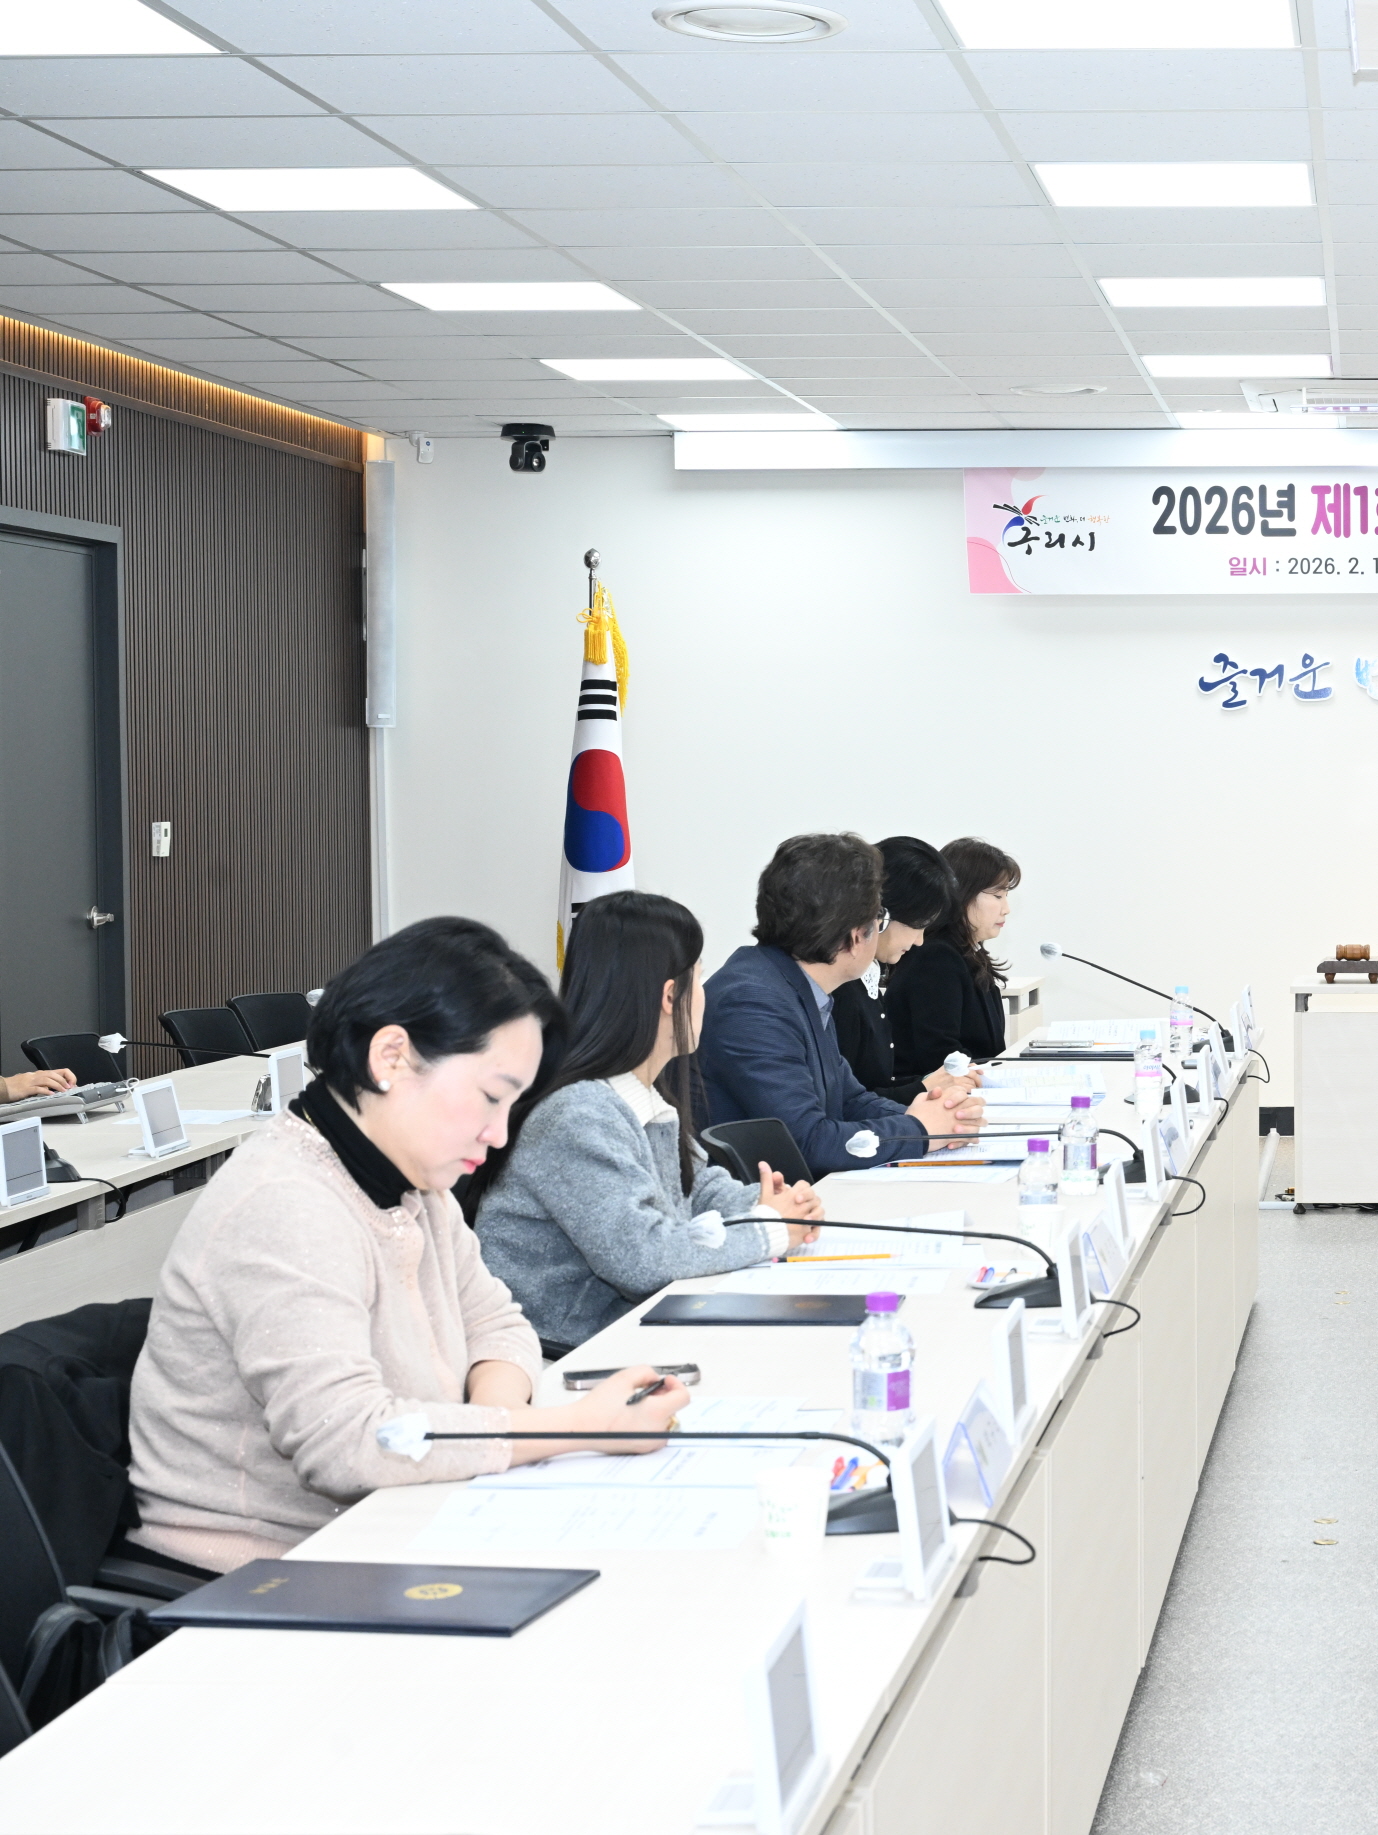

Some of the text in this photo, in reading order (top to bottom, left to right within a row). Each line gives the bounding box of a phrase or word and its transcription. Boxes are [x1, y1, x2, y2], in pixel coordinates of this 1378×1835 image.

[1152, 483, 1297, 538] 2026년
[1007, 526, 1095, 555] 구리시
[1228, 557, 1267, 576] 일시
[1288, 557, 1341, 575] 2026.
[1348, 557, 1365, 575] 2.
[1198, 652, 1333, 709] 즐거운
